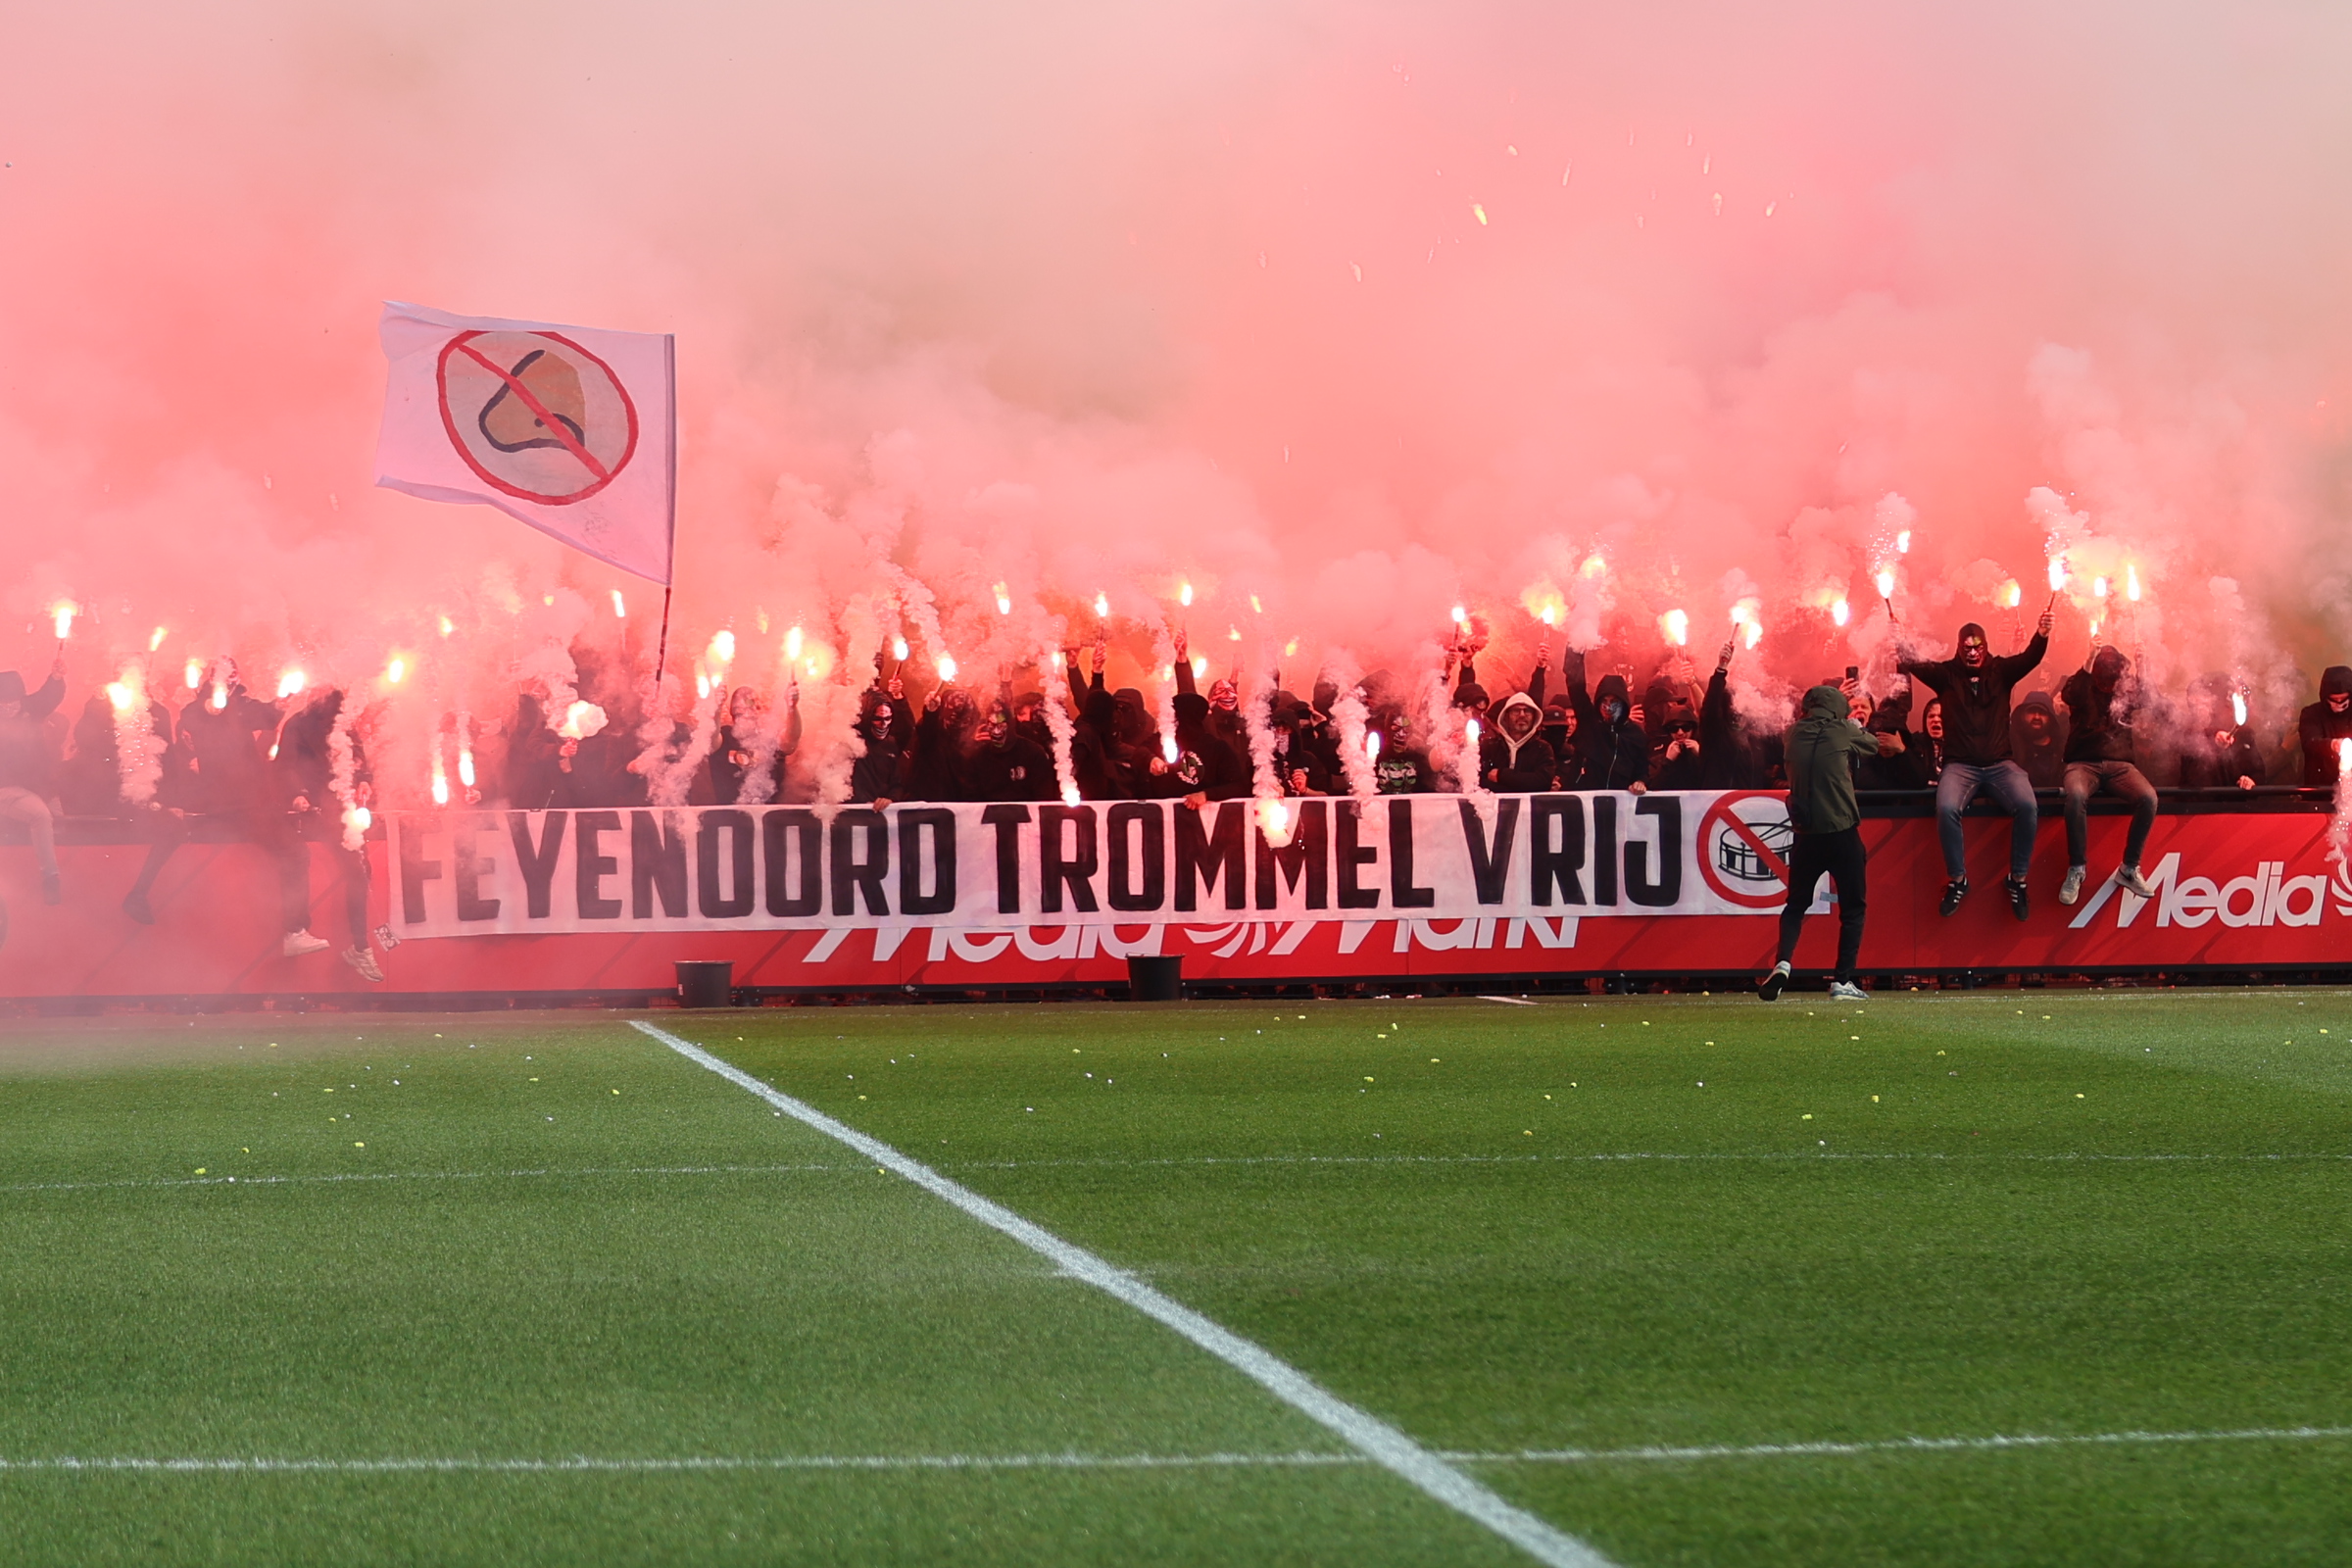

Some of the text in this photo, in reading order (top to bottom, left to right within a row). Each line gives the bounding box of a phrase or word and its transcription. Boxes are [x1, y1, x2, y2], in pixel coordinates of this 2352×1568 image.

[400, 795, 1683, 924] FEYENOORD TROMMEL VRIJ
[2068, 852, 2328, 928] Media
